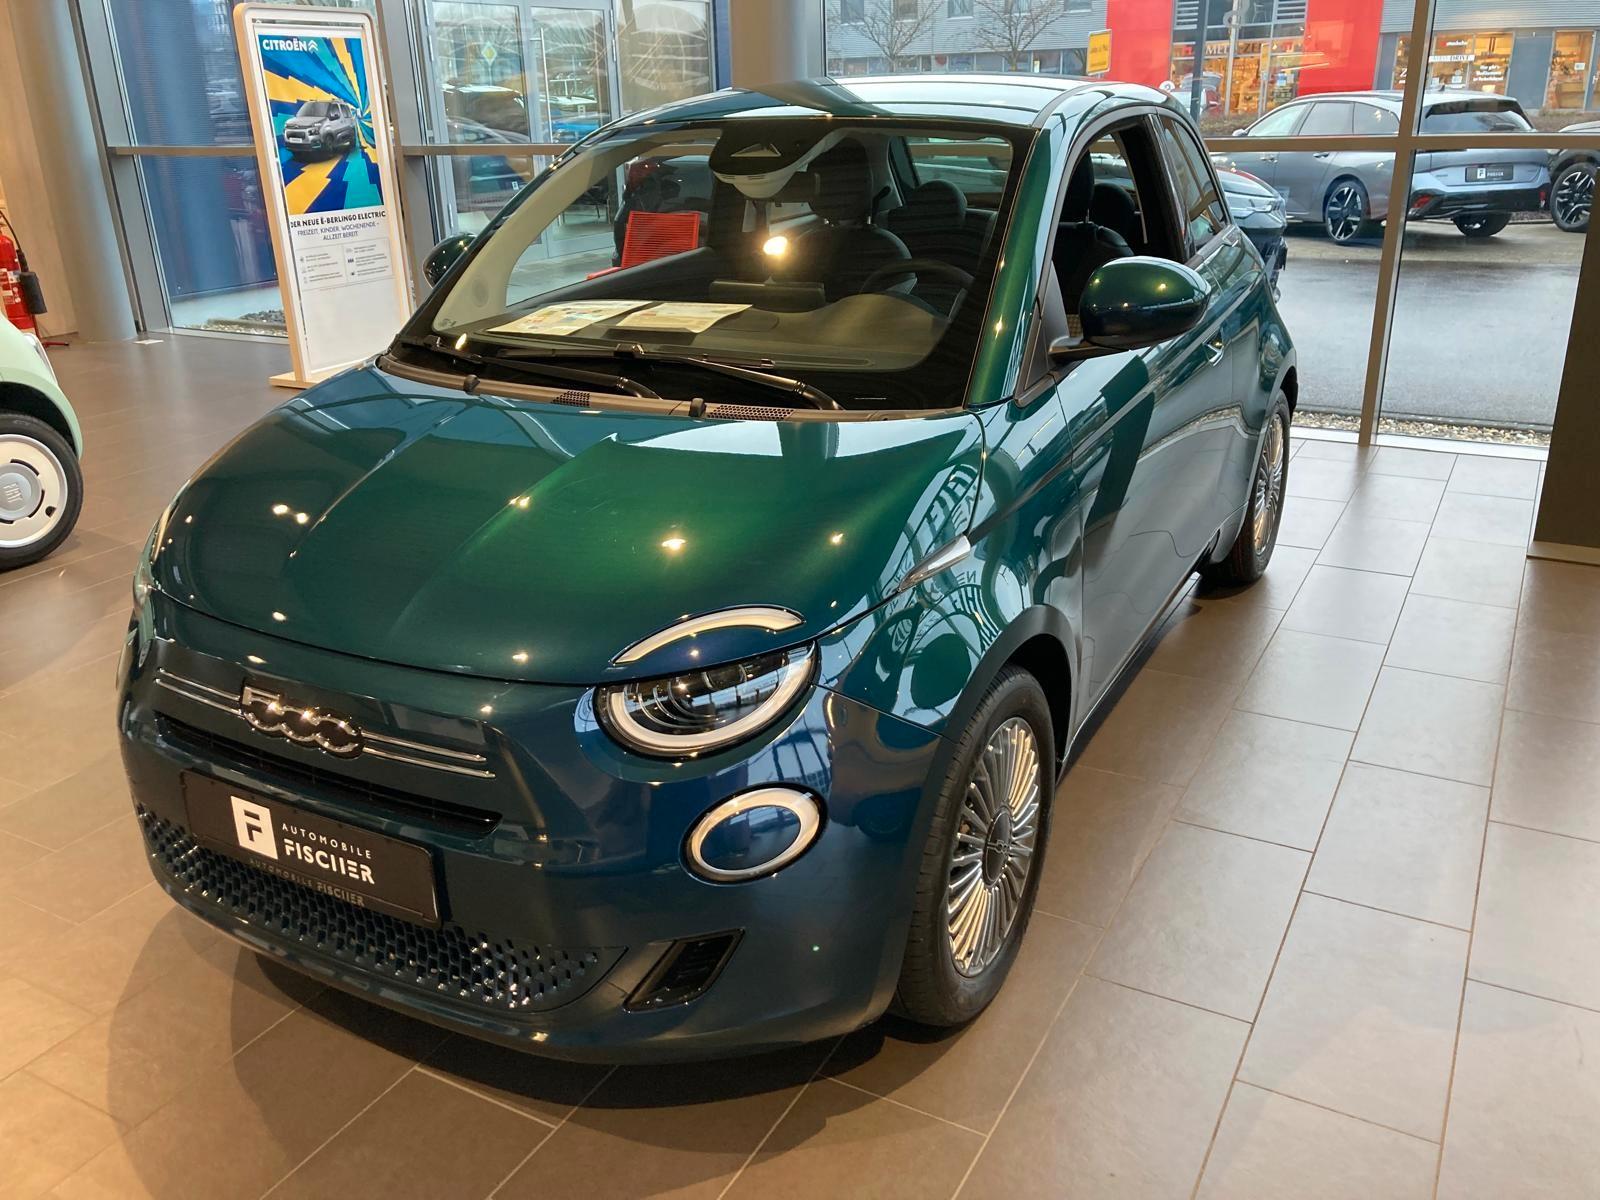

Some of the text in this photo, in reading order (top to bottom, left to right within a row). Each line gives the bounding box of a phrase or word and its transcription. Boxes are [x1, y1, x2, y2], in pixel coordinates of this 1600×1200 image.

[262, 38, 308, 52] CITROËN
[302, 218, 320, 227] NEUE
[357, 210, 386, 220] ELECTRIC
[241, 686, 359, 753] 500
[281, 823, 373, 860] AUTOMOBILE
[249, 857, 313, 888] AUTOMOBILE
